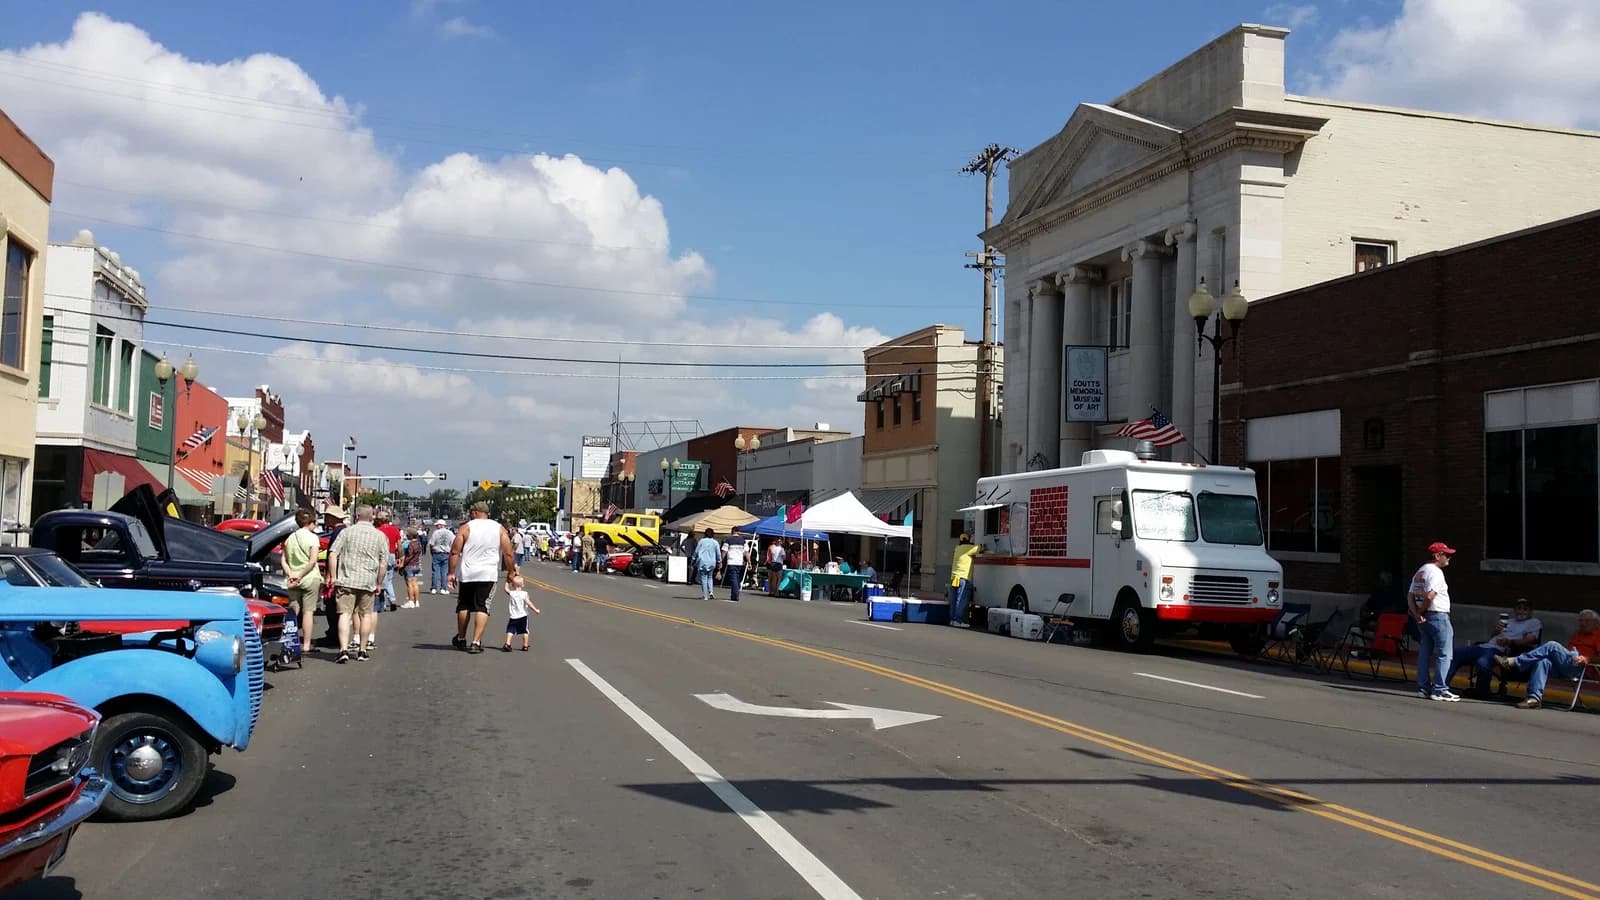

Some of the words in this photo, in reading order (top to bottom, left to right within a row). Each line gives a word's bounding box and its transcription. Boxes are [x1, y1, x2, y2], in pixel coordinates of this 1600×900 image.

[1070, 387, 1104, 395] MEMORIAL
[1073, 395, 1101, 403] MUSEUM
[1087, 403, 1100, 411] ART
